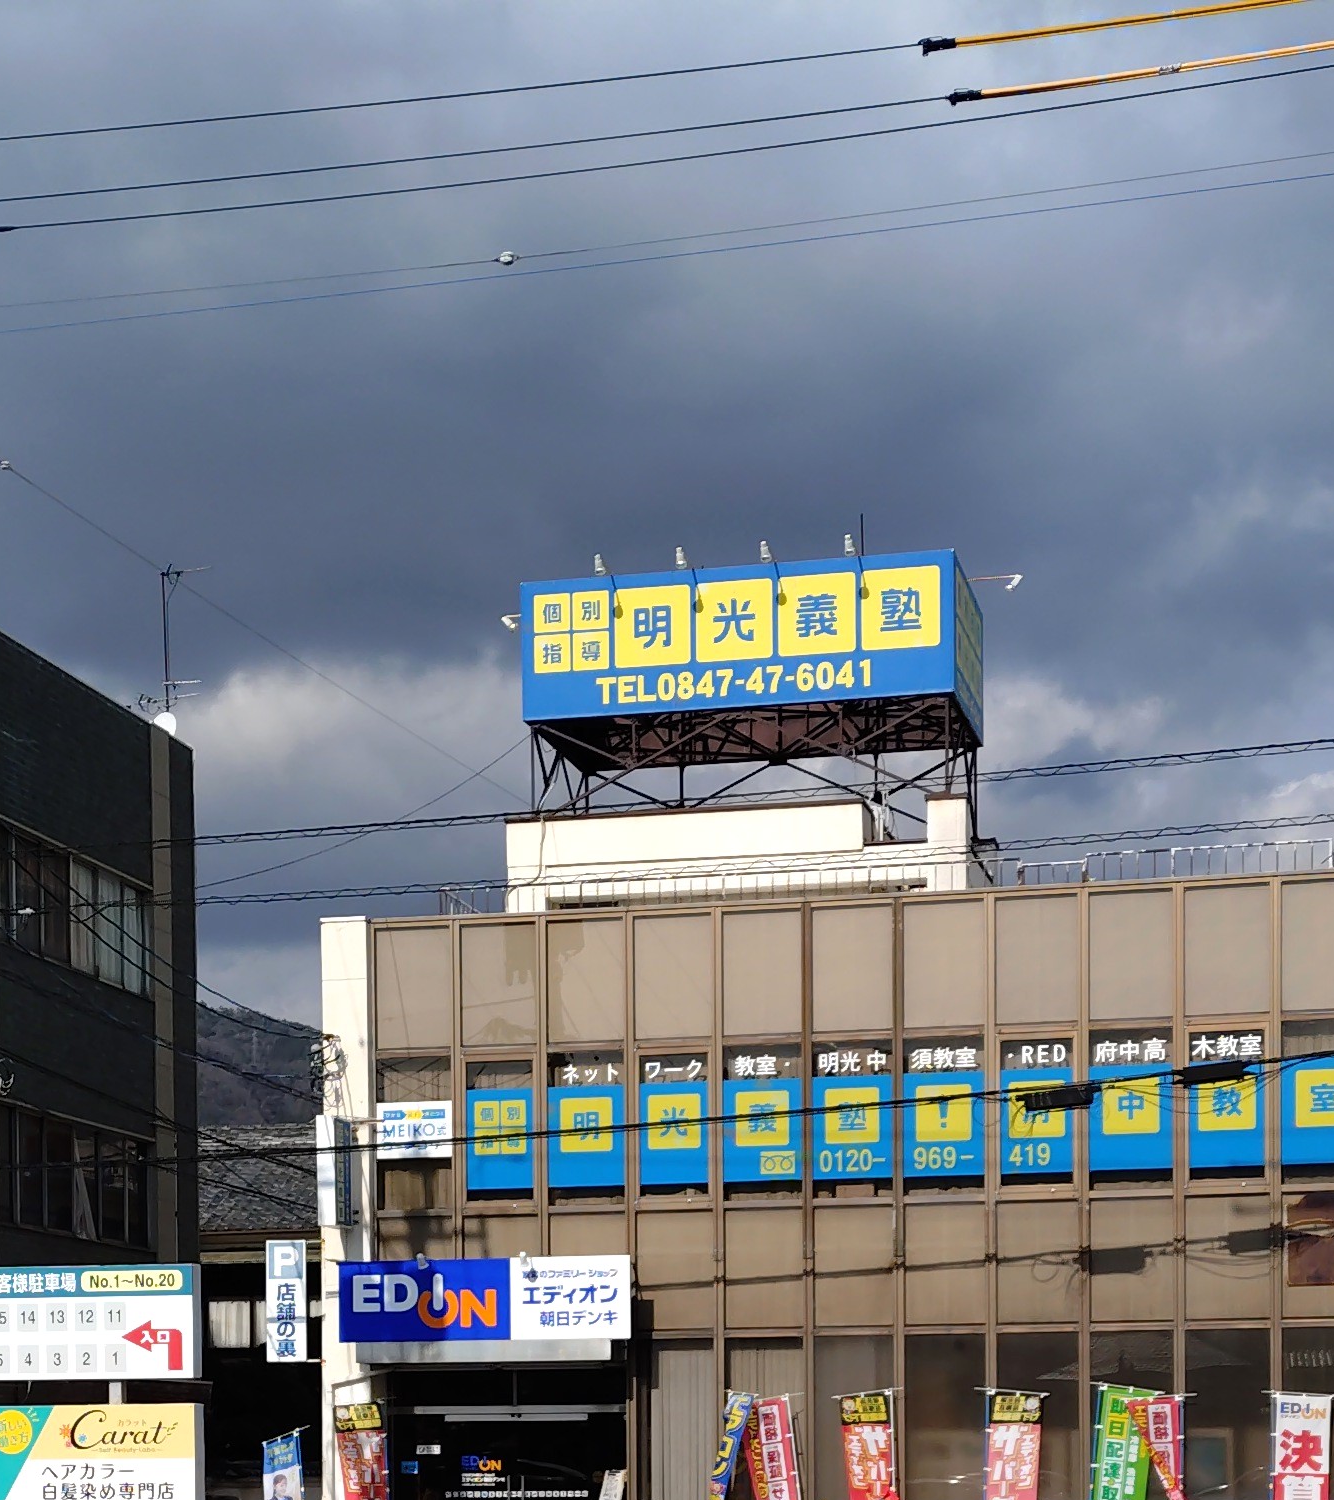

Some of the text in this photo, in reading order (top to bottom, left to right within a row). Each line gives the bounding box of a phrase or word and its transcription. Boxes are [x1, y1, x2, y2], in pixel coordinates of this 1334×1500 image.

[542, 600, 601, 625] 個別
[633, 588, 922, 650] 明光義塾
[542, 641, 602, 665] 指導
[273, 1246, 299, 1277] P
[352, 1272, 497, 1328] EDION
[522, 1284, 619, 1305] エディオン
[20, 1310, 36, 1324] 14
[49, 1309, 65, 1324] 13
[78, 1309, 94, 1324] 12
[107, 1309, 121, 1323] 11
[276, 1282, 297, 1358] 店舗の裏
[539, 1310, 618, 1327] 朝日デンキ
[140, 1330, 170, 1344] 入口
[24, 1352, 33, 1367] 4
[53, 1352, 62, 1366] 3
[82, 1351, 91, 1366] 2
[112, 1351, 119, 1366] 1
[1280, 1402, 1327, 1420] EDION
[70, 1409, 168, 1450] Carat
[41, 1463, 134, 1480] ヘアカラー
[42, 1481, 174, 1500] 白髪染め専門店
